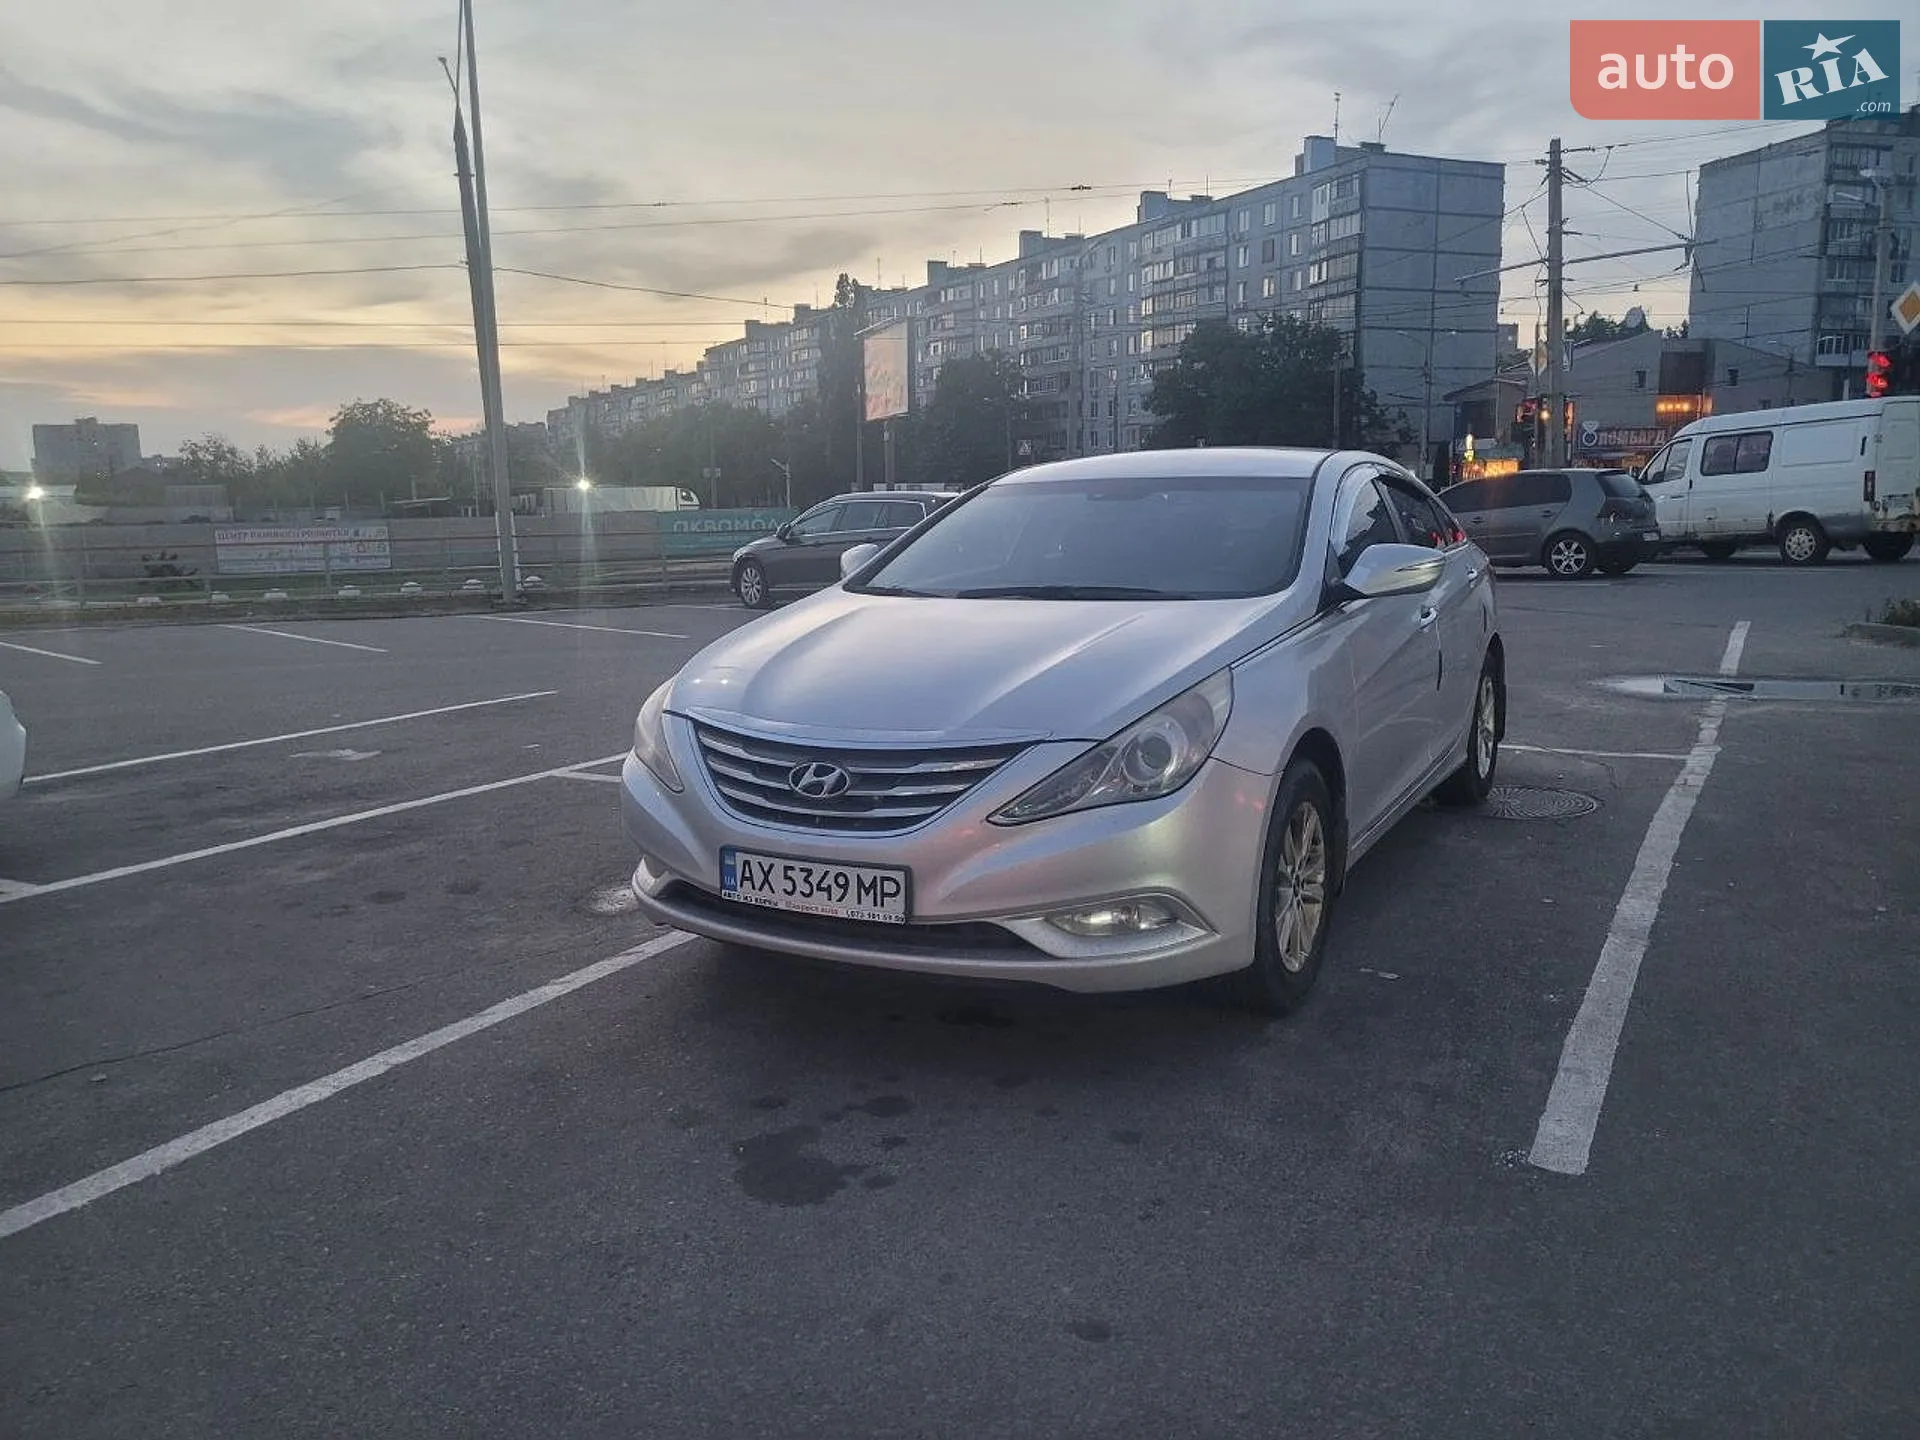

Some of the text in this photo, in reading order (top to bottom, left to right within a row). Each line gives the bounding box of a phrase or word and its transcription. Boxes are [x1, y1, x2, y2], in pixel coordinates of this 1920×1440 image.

[1598, 429, 1666, 447] ЛОМБАРД
[740, 860, 901, 908] AX 5349 MP
